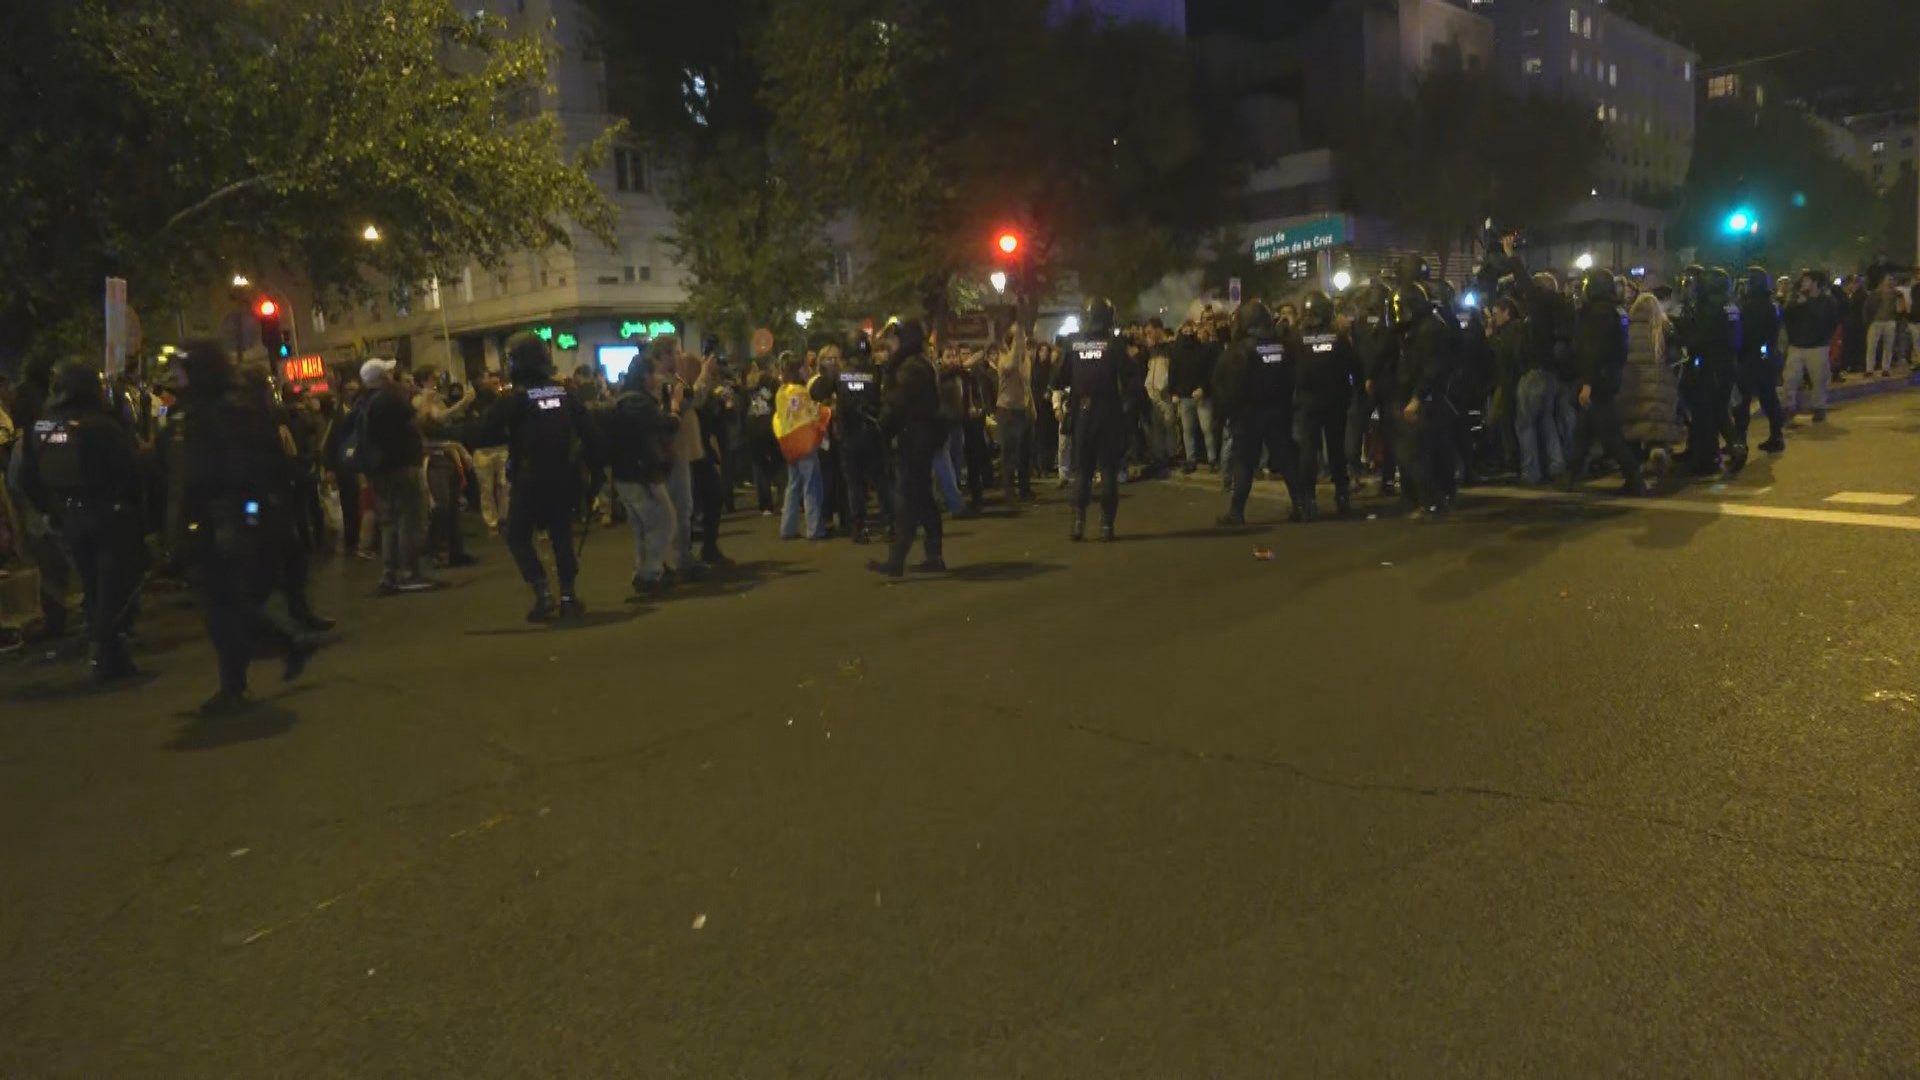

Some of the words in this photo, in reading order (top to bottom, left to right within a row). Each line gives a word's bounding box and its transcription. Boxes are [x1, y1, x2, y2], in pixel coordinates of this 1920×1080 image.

[1275, 232, 1285, 243] de
[1255, 251, 1270, 261] San
[1292, 240, 1302, 253] de
[1303, 239, 1312, 250] la
[1313, 235, 1333, 247] Cruz
